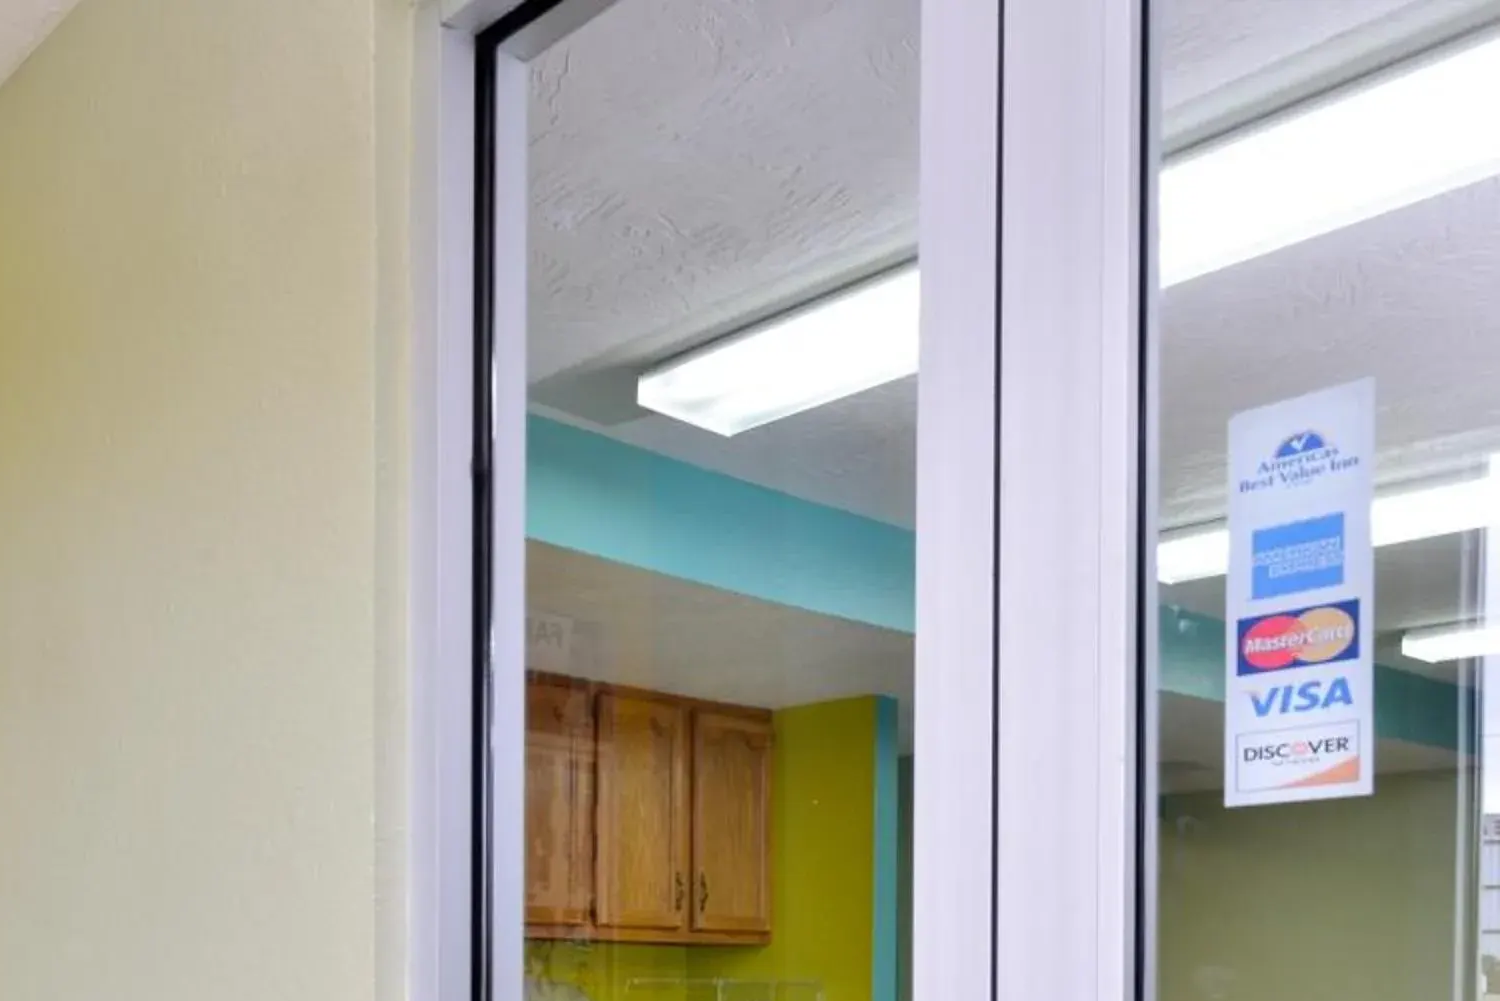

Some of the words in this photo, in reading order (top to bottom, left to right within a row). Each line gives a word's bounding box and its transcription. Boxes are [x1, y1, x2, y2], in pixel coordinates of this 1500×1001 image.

[1244, 626, 1351, 654] MasterCard
[1245, 676, 1354, 718] VISA
[1243, 735, 1350, 763] DISCOVER
